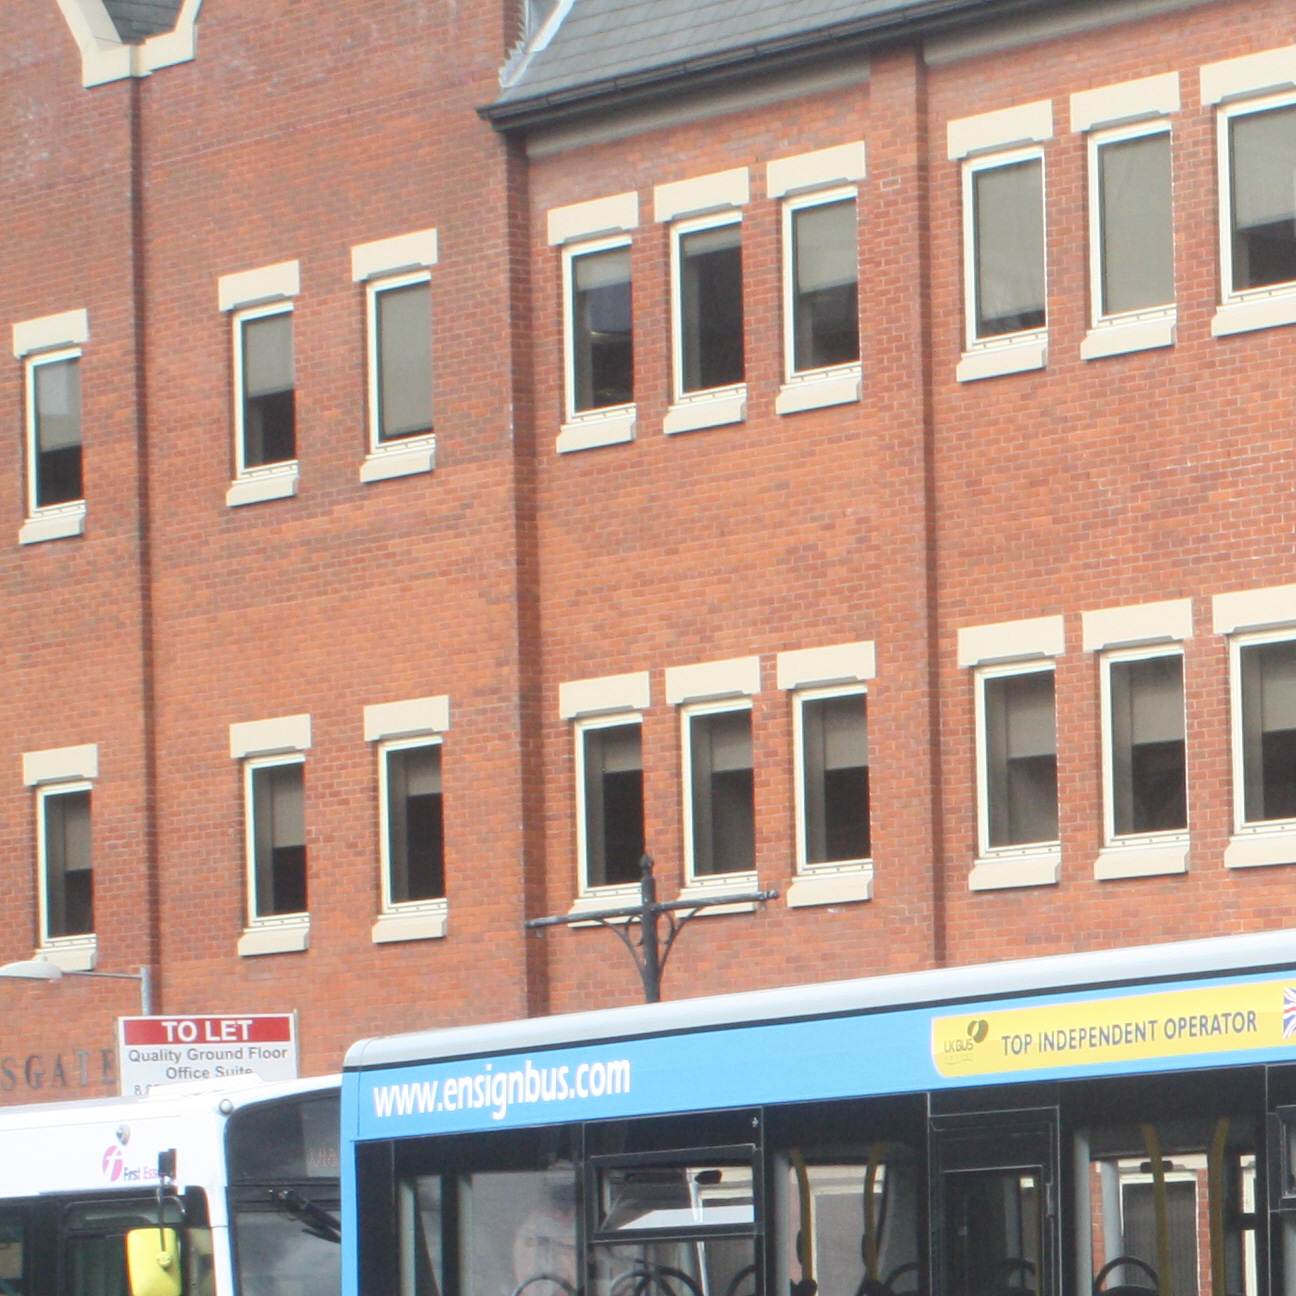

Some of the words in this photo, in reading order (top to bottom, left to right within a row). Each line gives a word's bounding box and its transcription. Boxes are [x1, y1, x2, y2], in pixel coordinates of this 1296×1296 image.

[161, 1020, 198, 1042] TO
[205, 1019, 253, 1042] LET
[1002, 1032, 1033, 1057] TOP
[1038, 1018, 1157, 1053] INDEPENDENT
[1163, 1010, 1258, 1044] OPERATOR
[128, 1048, 182, 1063] Quality
[187, 1047, 243, 1061] Ground
[248, 1046, 288, 1060] Floor
[166, 1066, 210, 1080] Office
[373, 1059, 631, 1120] www.ensignbus.com
[123, 1167, 141, 1181] First
